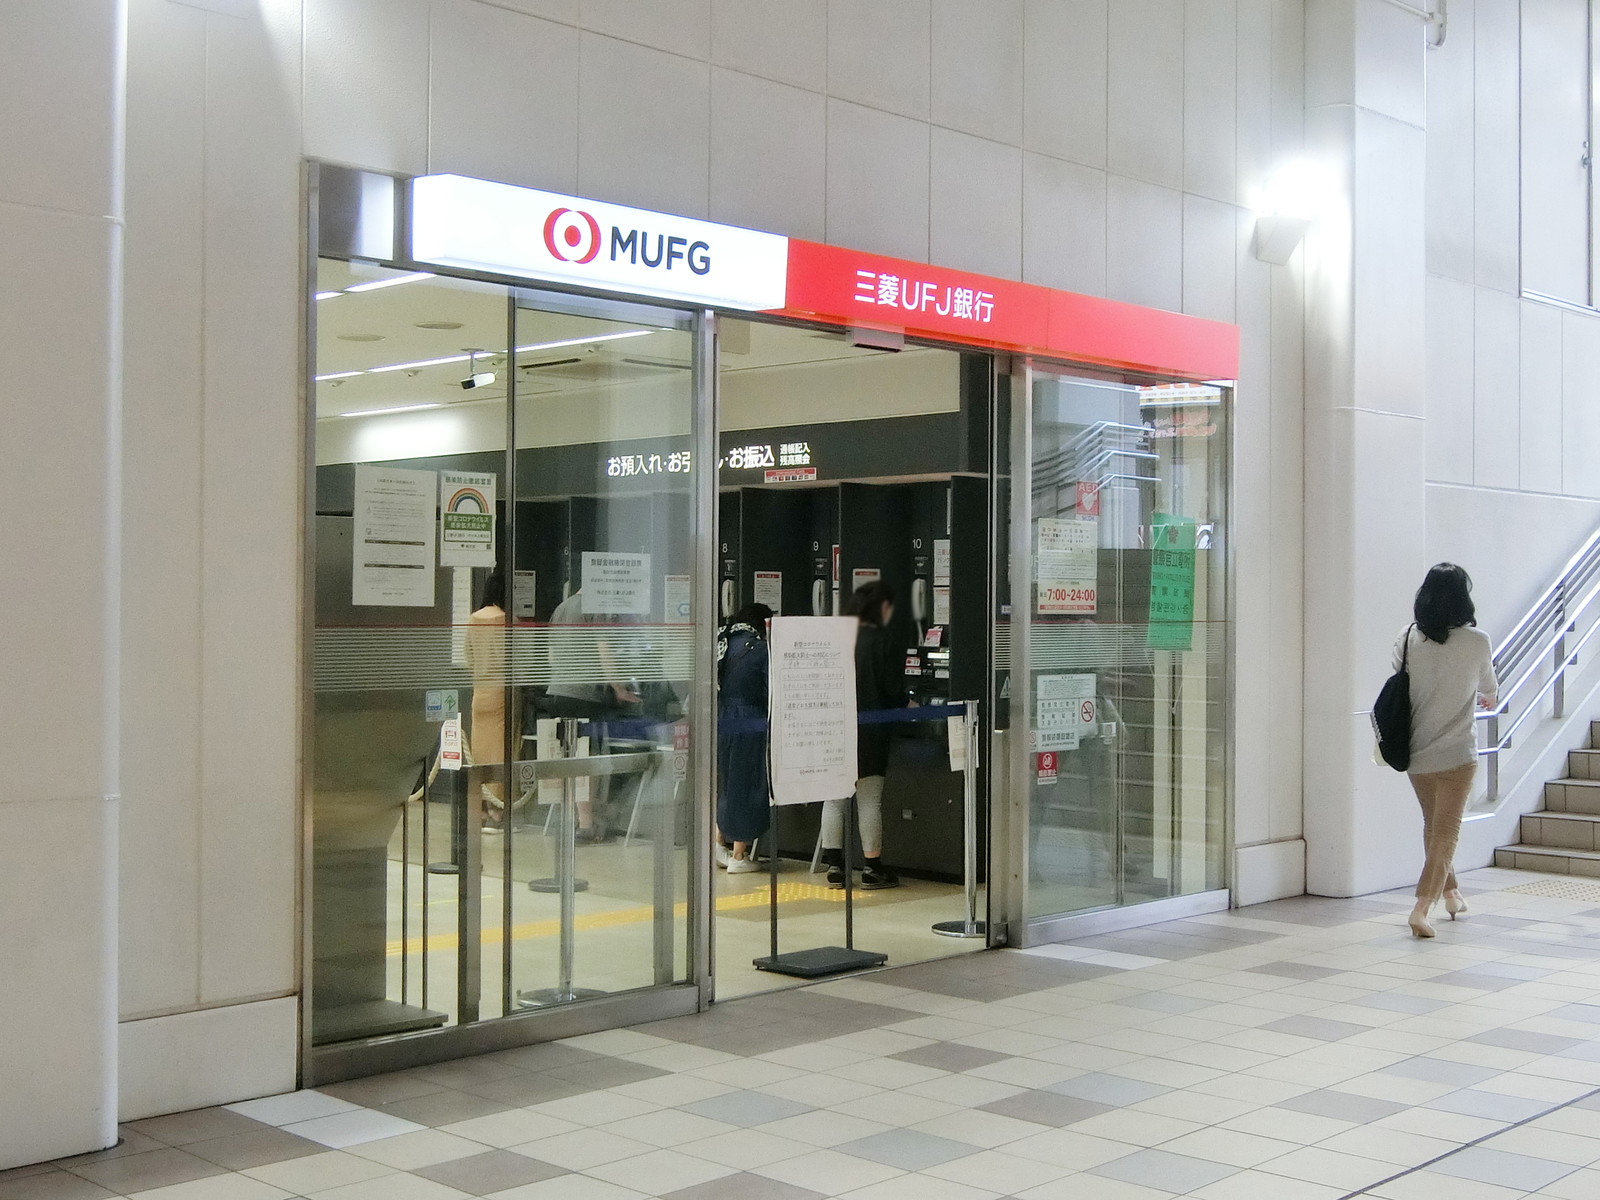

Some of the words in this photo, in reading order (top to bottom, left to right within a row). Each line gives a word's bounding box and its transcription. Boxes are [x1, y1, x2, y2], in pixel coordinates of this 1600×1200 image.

[610, 225, 711, 276] MUFG
[853, 270, 995, 323] 三菱UFJ銀行
[722, 542, 728, 553] 8
[813, 541, 819, 552] 9
[912, 538, 922, 549] 10
